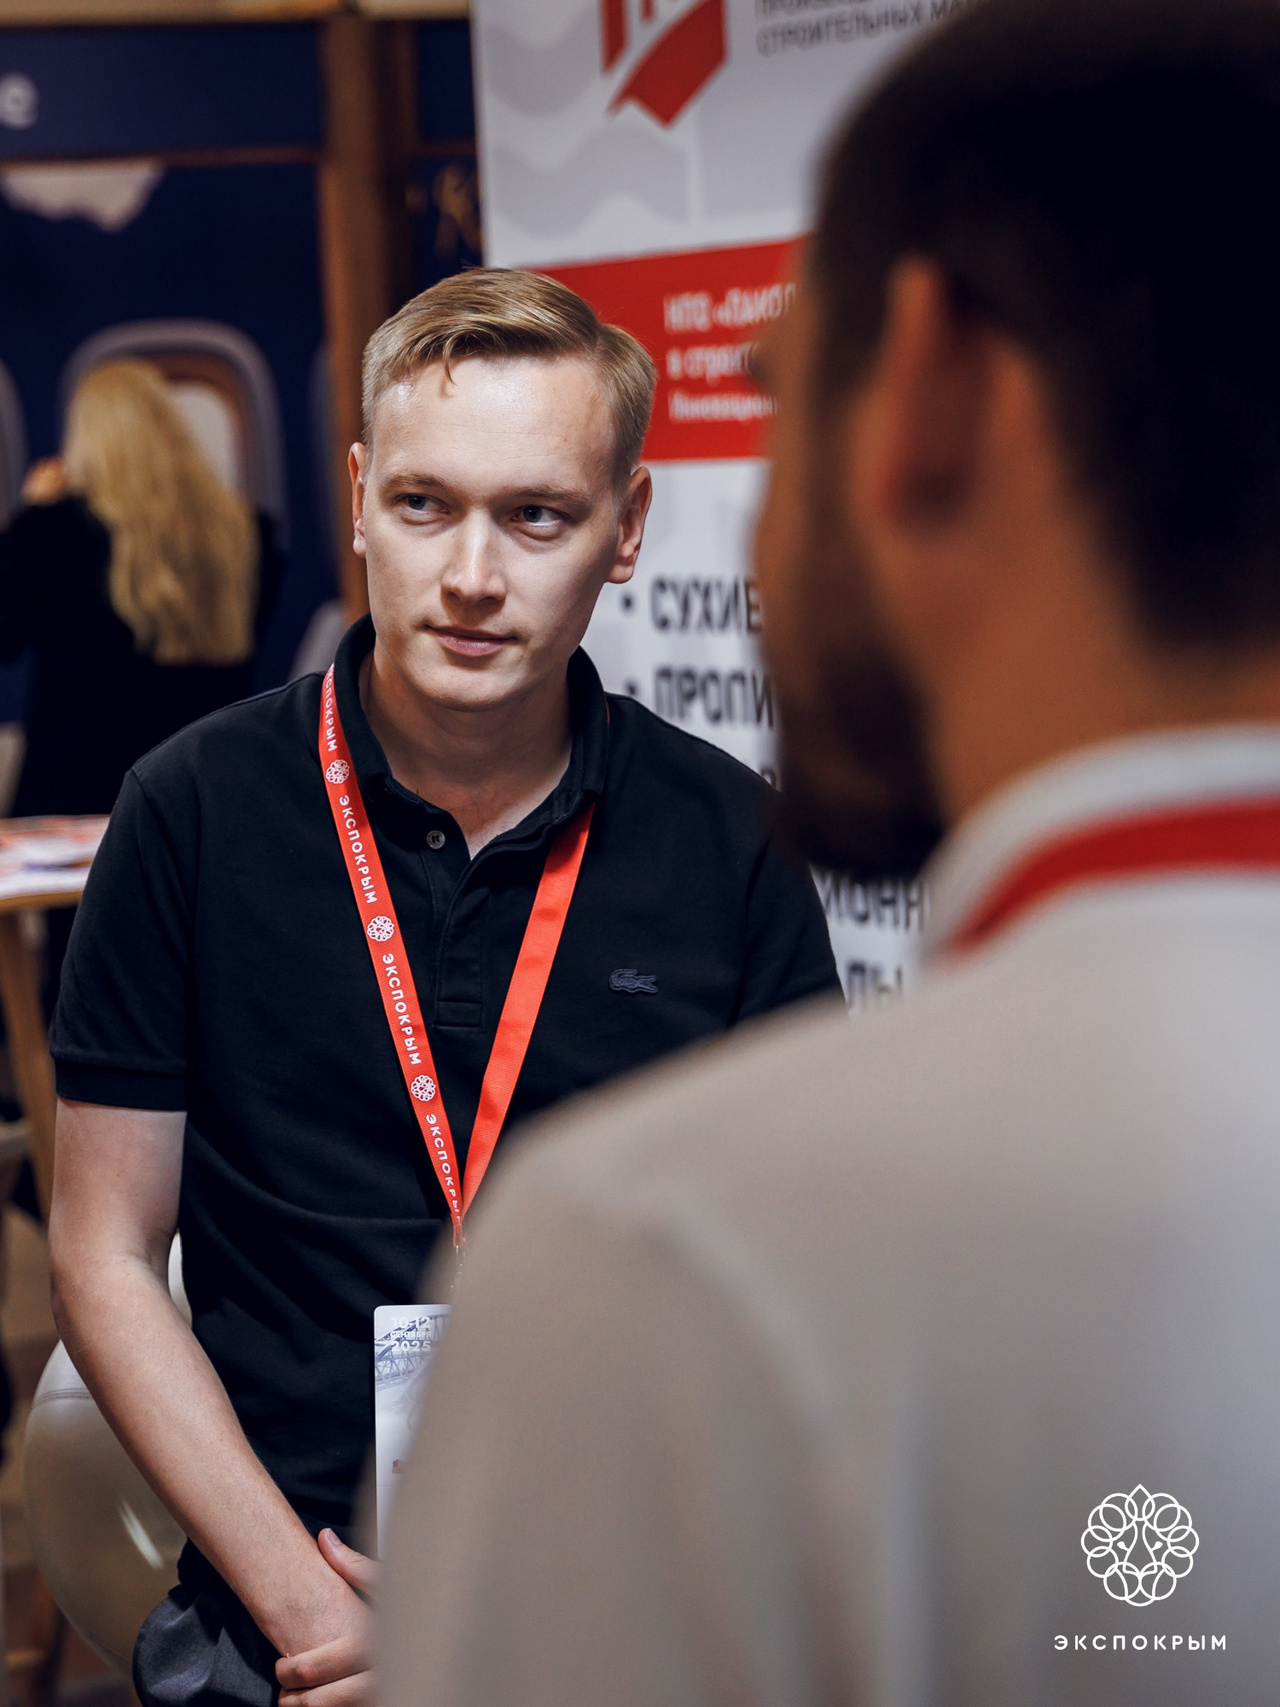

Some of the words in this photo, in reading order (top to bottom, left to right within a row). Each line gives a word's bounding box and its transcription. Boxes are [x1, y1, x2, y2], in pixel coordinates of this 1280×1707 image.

[651, 577, 762, 633] СУХИЕ
[655, 666, 775, 730] ПРОПИ
[339, 795, 378, 904] ЭКСПОКРЫМ
[382, 952, 422, 1065] ЭКСПОКРЫМ
[391, 1340, 431, 1352] 2025
